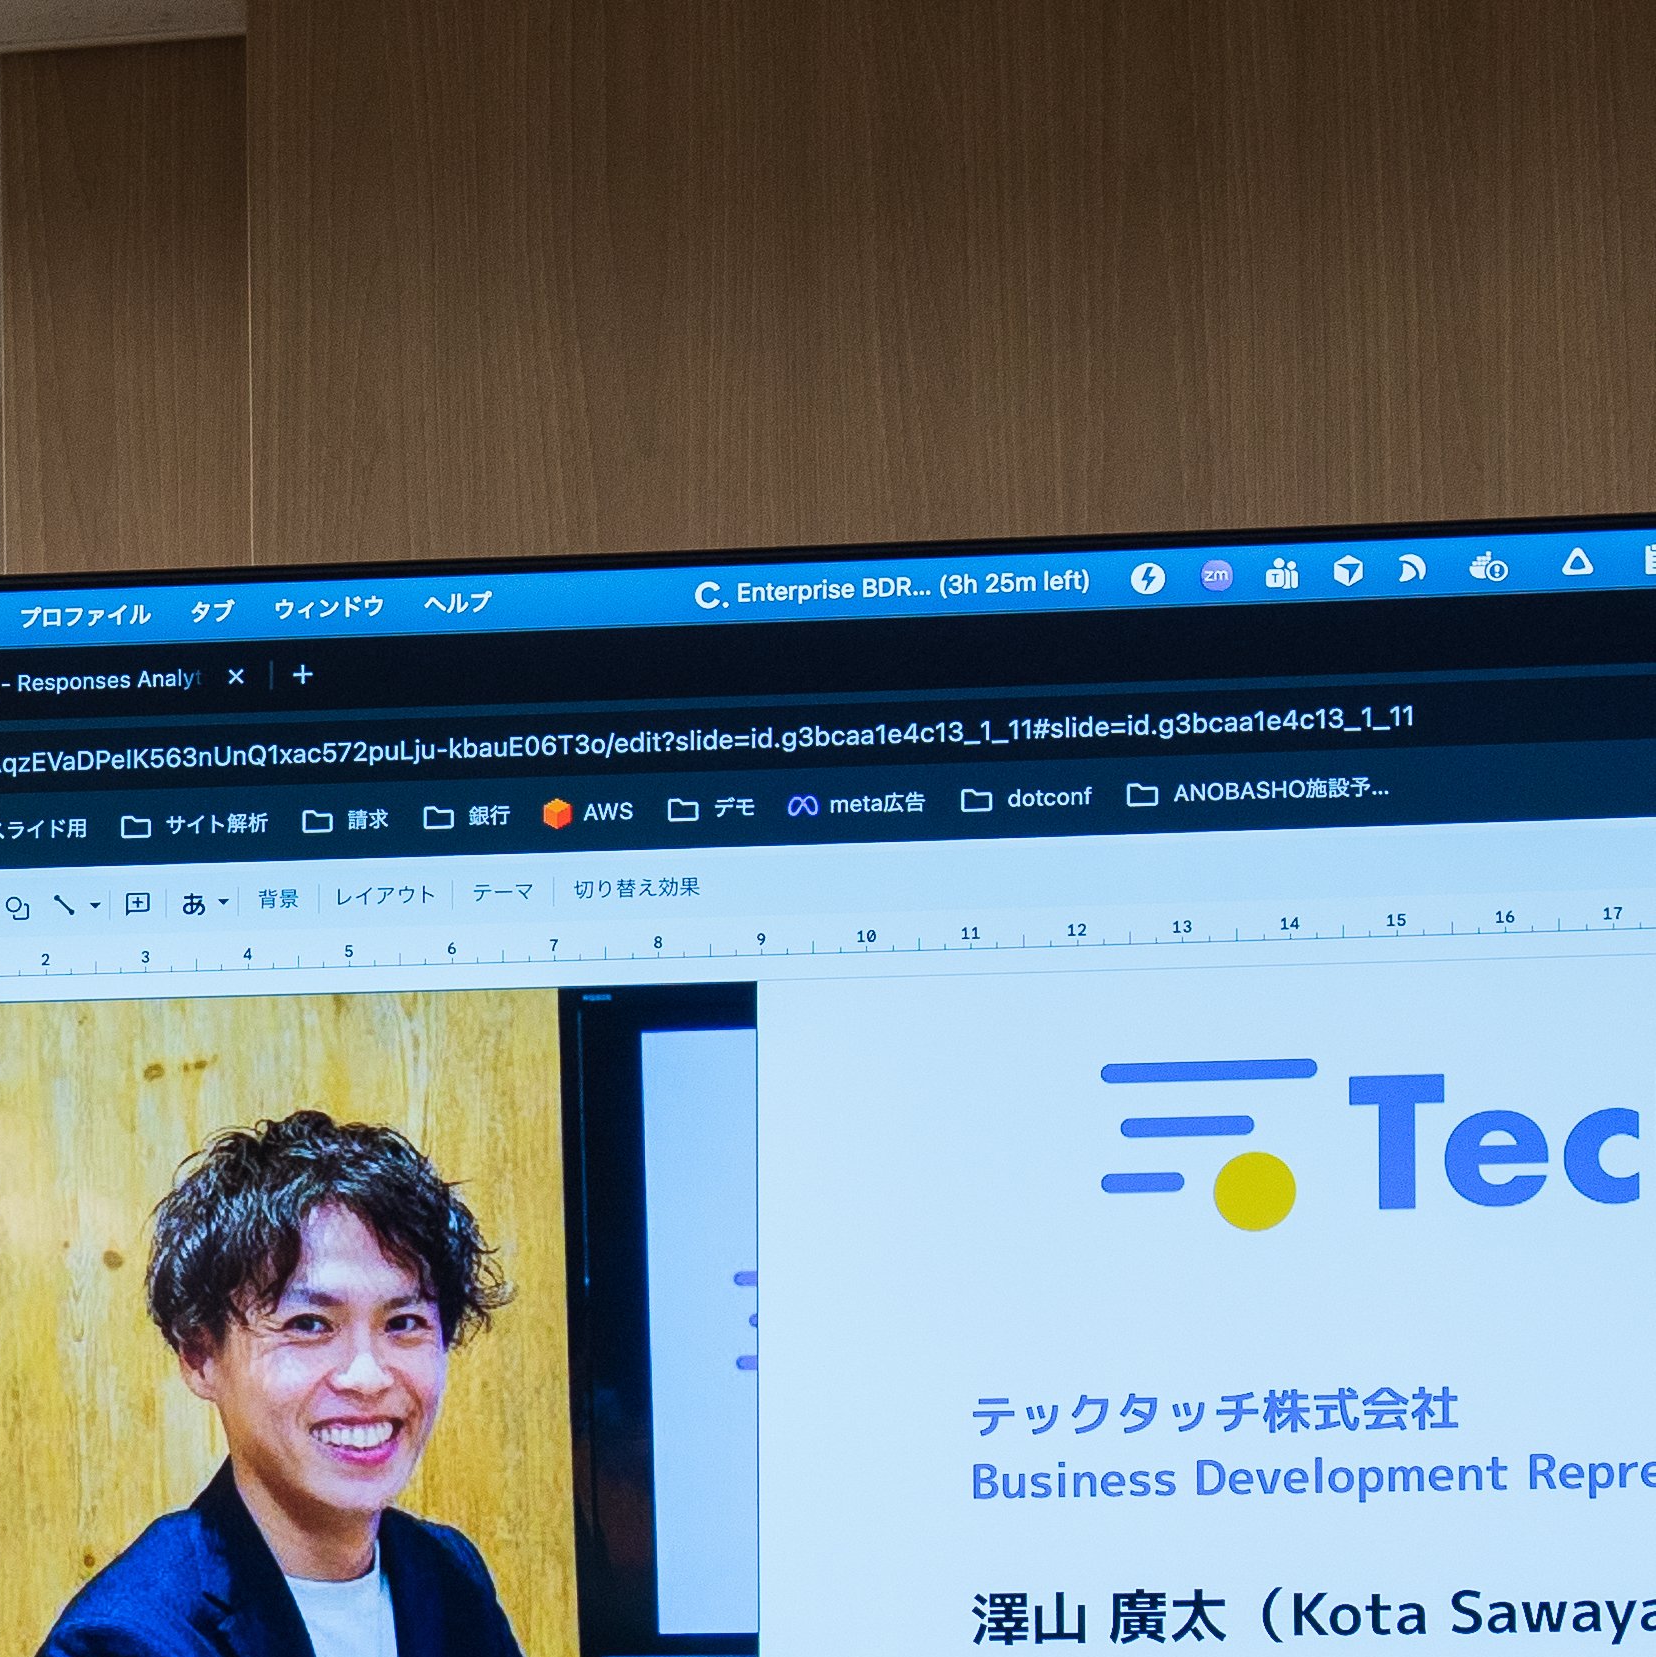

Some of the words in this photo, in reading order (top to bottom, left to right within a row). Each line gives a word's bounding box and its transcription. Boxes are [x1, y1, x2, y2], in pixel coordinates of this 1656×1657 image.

[738, 579, 855, 604] Enterprise
[863, 577, 931, 597] BDR...
[940, 574, 977, 598] (3h
[986, 573, 1035, 593] 25m
[1044, 569, 1089, 593] left)
[192, 599, 235, 622] タブ
[275, 595, 383, 619] ウィンドウ
[424, 591, 492, 613] ヘルプ
[21, 605, 151, 628] プロファイル
[17, 667, 131, 694] Responses
[1008, 787, 1092, 807] dotconf
[1174, 777, 1388, 802] ANOBASHO施設予...
[584, 802, 633, 821] AWS
[715, 797, 754, 817] デモ
[831, 792, 926, 813] meta広告
[166, 813, 268, 834] サイト解析
[348, 809, 388, 830] 請求
[469, 805, 510, 825] 銀行
[259, 889, 298, 909] 背景
[338, 886, 434, 905] レイアウト
[474, 884, 532, 901] テーマ
[574, 877, 700, 899] 切り替え効果
[42, 954, 50, 965] 2
[142, 951, 149, 963] 3
[244, 948, 252, 960] 4
[345, 945, 353, 957] 5
[448, 942, 456, 954] 6
[550, 939, 558, 951] 7
[654, 936, 662, 948] 8
[757, 933, 765, 945] 9
[857, 930, 876, 942] 10
[962, 927, 980, 939] 11
[1068, 924, 1086, 936] 12
[1173, 920, 1192, 933] 13
[1281, 917, 1299, 930] 14
[1387, 914, 1406, 926] 15
[1496, 911, 1515, 923] 16
[1604, 907, 1622, 920] 17
[1349, 1074, 1640, 1210] Tec
[973, 1386, 1458, 1436] テックタッチ株式会社
[973, 1462, 1176, 1499] Business
[1197, 1457, 1508, 1503] Development
[1530, 1454, 1656, 1499] Repre
[972, 1592, 1085, 1645] 澤山
